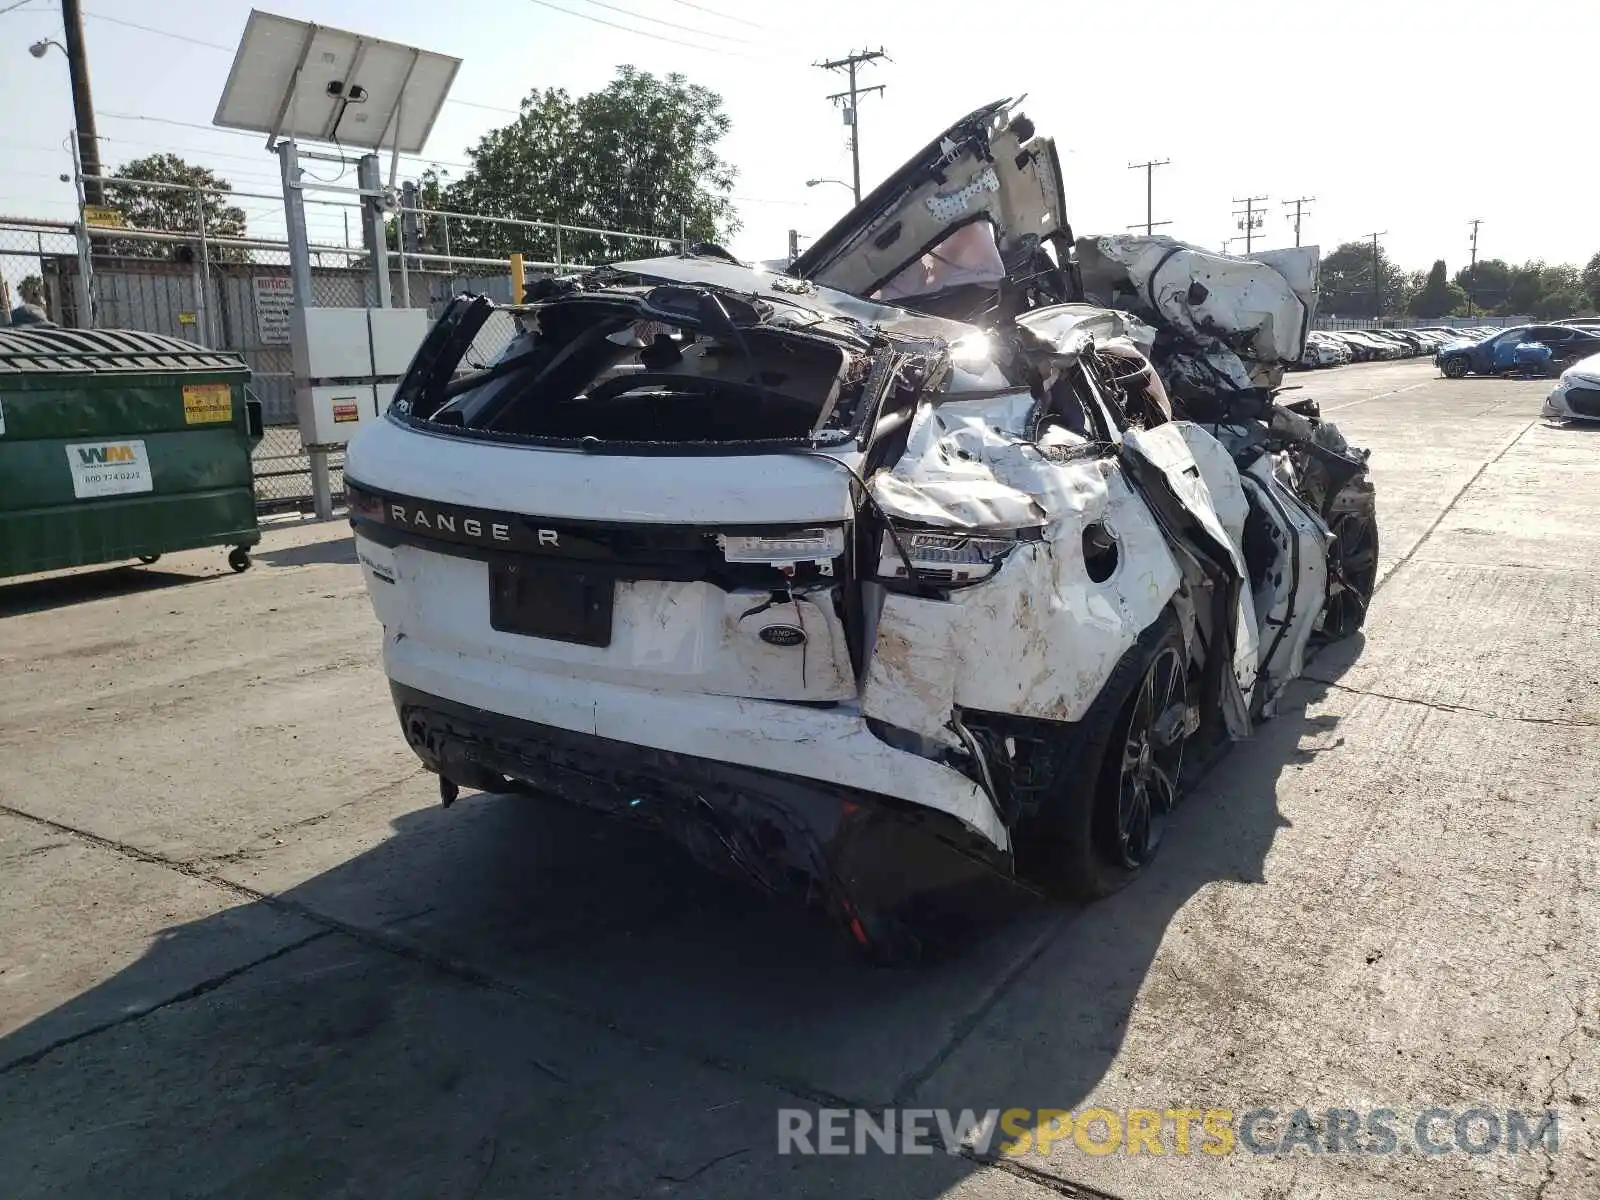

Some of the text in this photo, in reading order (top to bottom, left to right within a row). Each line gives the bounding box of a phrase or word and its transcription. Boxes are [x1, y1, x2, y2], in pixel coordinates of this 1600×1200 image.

[78, 446, 135, 464] WM
[391, 504, 560, 547] RANGE R
